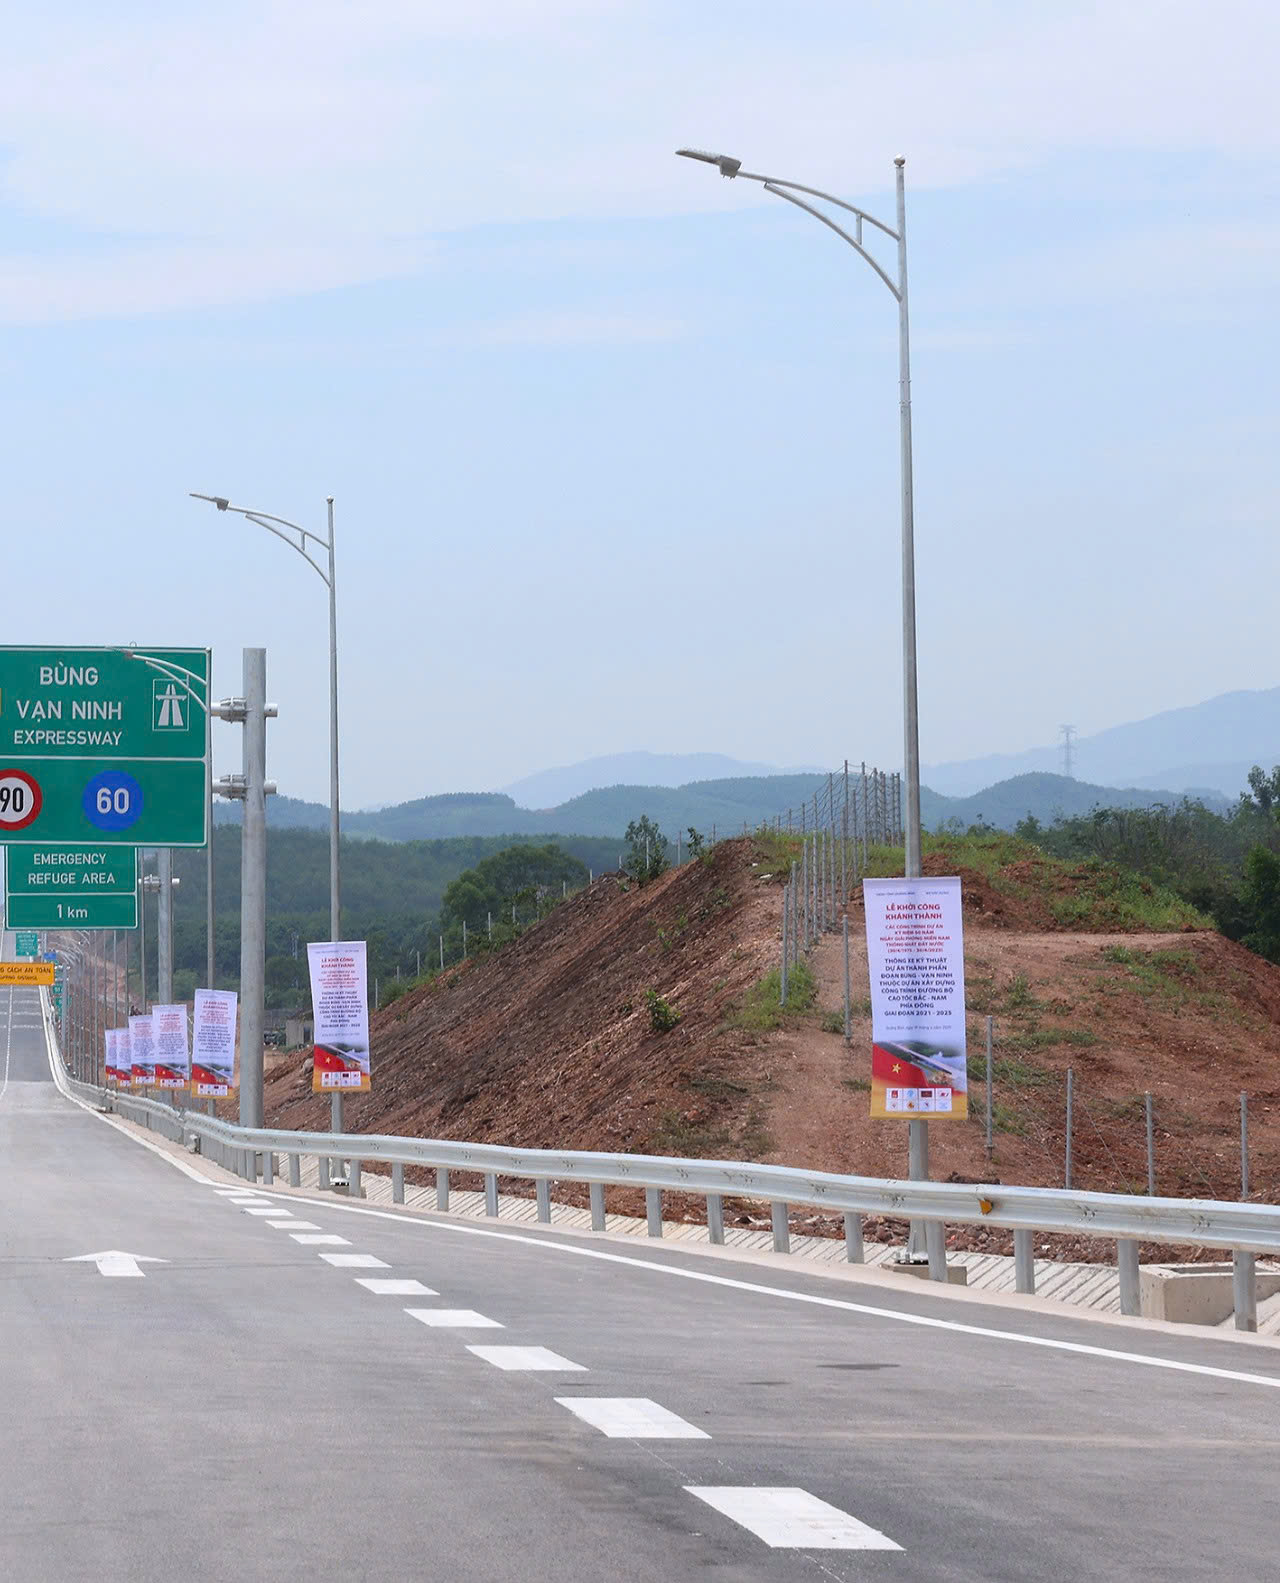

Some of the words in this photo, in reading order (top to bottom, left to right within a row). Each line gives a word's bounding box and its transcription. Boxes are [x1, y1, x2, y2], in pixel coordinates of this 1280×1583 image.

[39, 661, 99, 686] BÙNG
[16, 700, 62, 723] VẠN
[72, 700, 122, 721] NINH
[13, 730, 122, 746] EXPRESSWAY
[0, 786, 24, 813] 90
[96, 787, 130, 814] 60
[33, 853, 107, 865] EMERGENCY
[28, 872, 76, 885] REFUGE
[81, 872, 116, 884] AREA
[56, 903, 63, 918] 1
[67, 906, 88, 918] km
